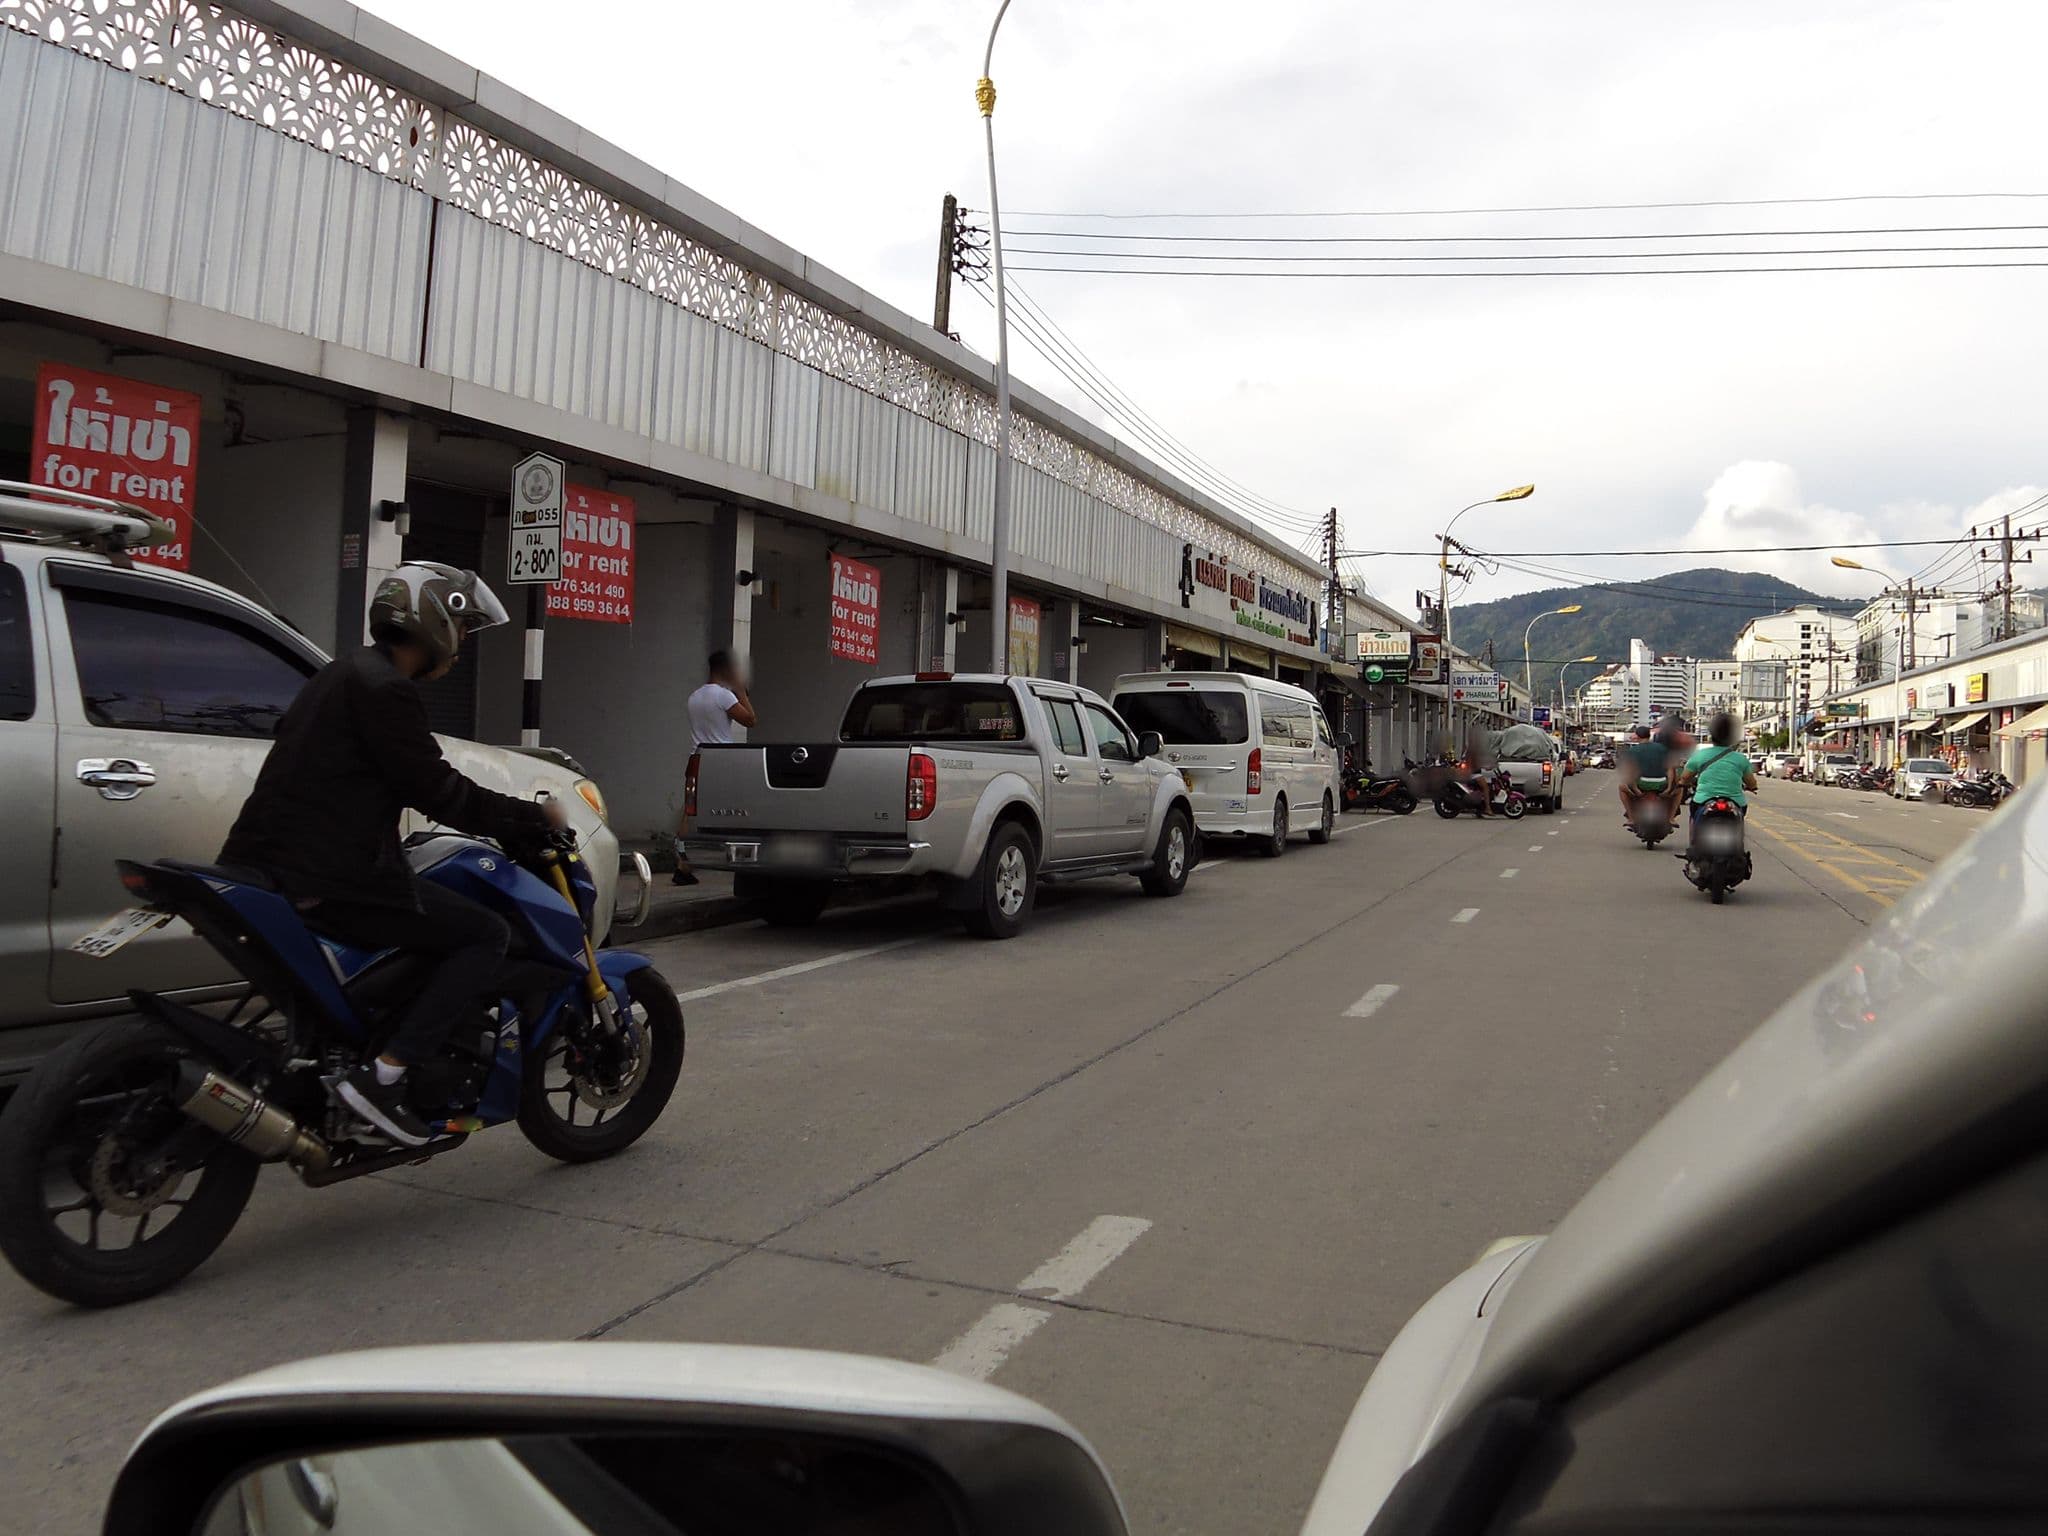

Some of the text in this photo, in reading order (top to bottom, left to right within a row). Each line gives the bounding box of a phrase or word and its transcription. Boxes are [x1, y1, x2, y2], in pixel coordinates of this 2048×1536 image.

[48, 379, 190, 467] ให้เช่า
[43, 454, 184, 504] for rent
[564, 495, 630, 550] ห้เช่า
[526, 533, 543, 545] กม.
[561, 551, 629, 576] or rent
[579, 581, 601, 596] 341
[604, 584, 625, 599] 490
[832, 561, 878, 609] ให้เช่า
[573, 598, 595, 613] 959
[831, 600, 876, 629] for rent
[1465, 691, 1498, 699] PHARMACY
